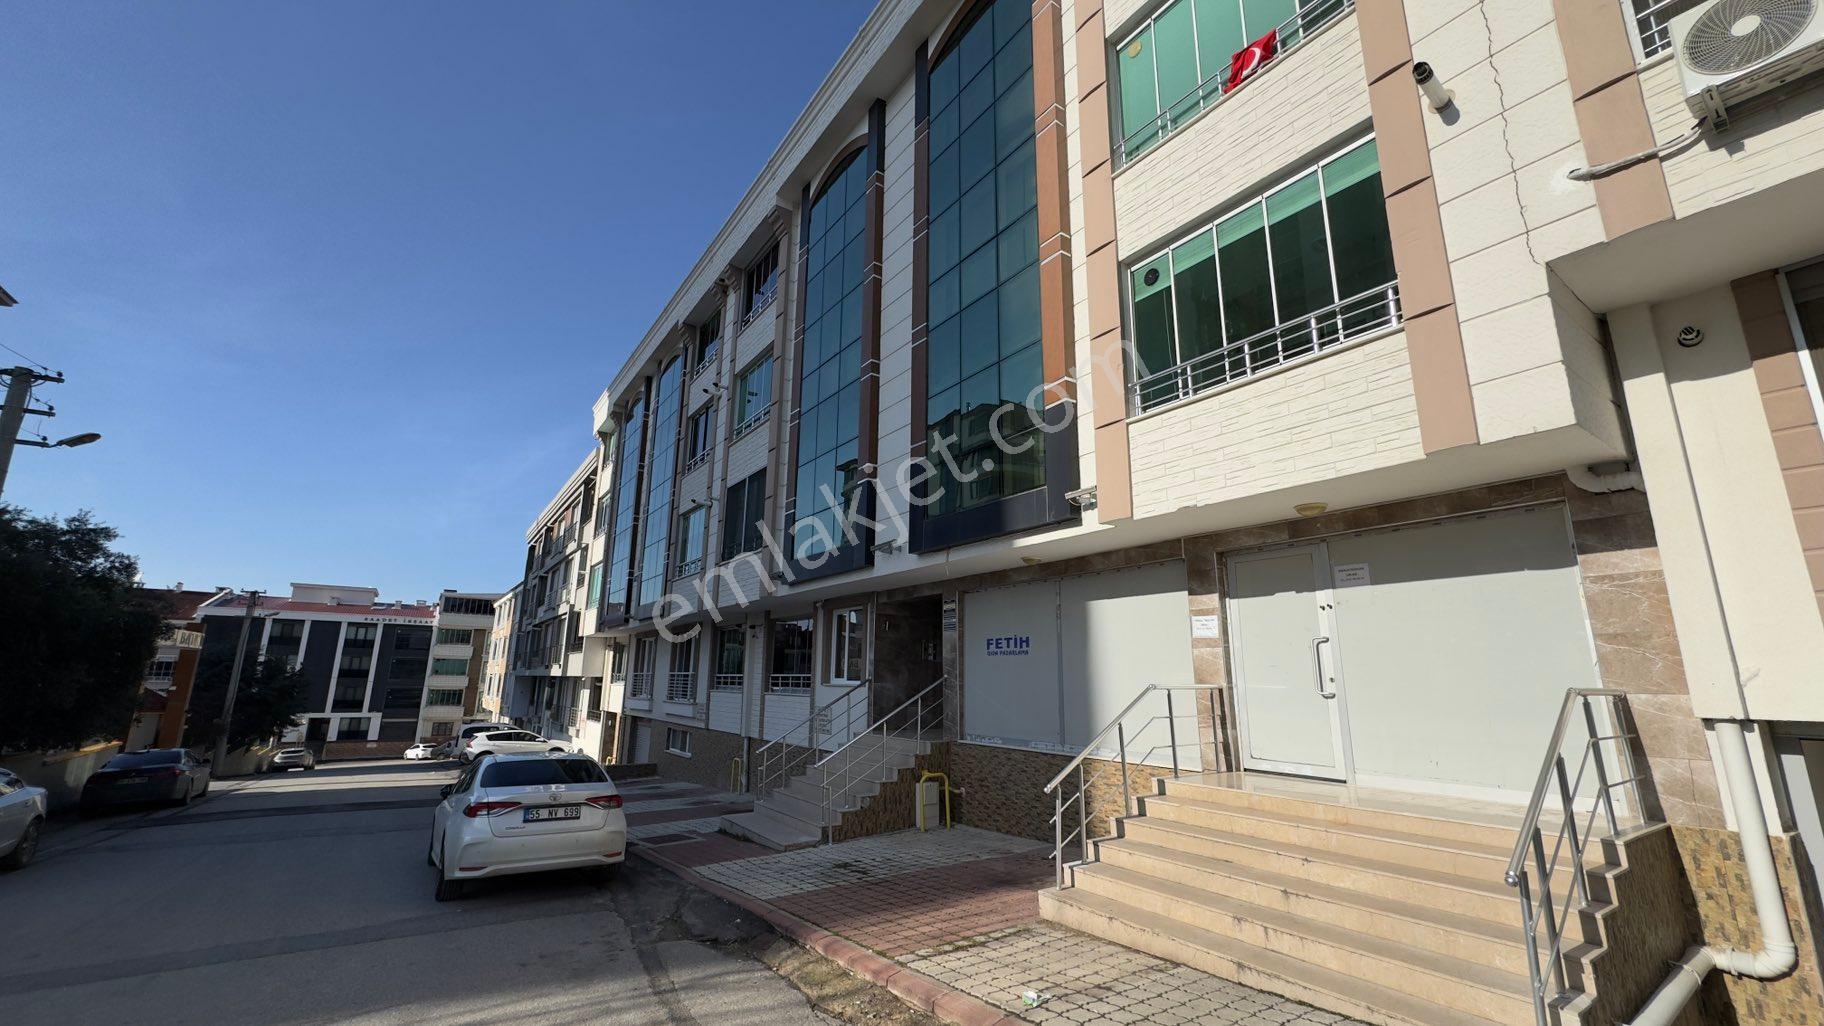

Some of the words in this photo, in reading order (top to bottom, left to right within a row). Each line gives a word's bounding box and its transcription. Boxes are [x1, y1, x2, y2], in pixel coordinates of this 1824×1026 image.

[986, 634, 1030, 650] FETİH
[530, 809, 540, 819] 55
[548, 808, 558, 817] NV
[564, 807, 579, 817] 699
